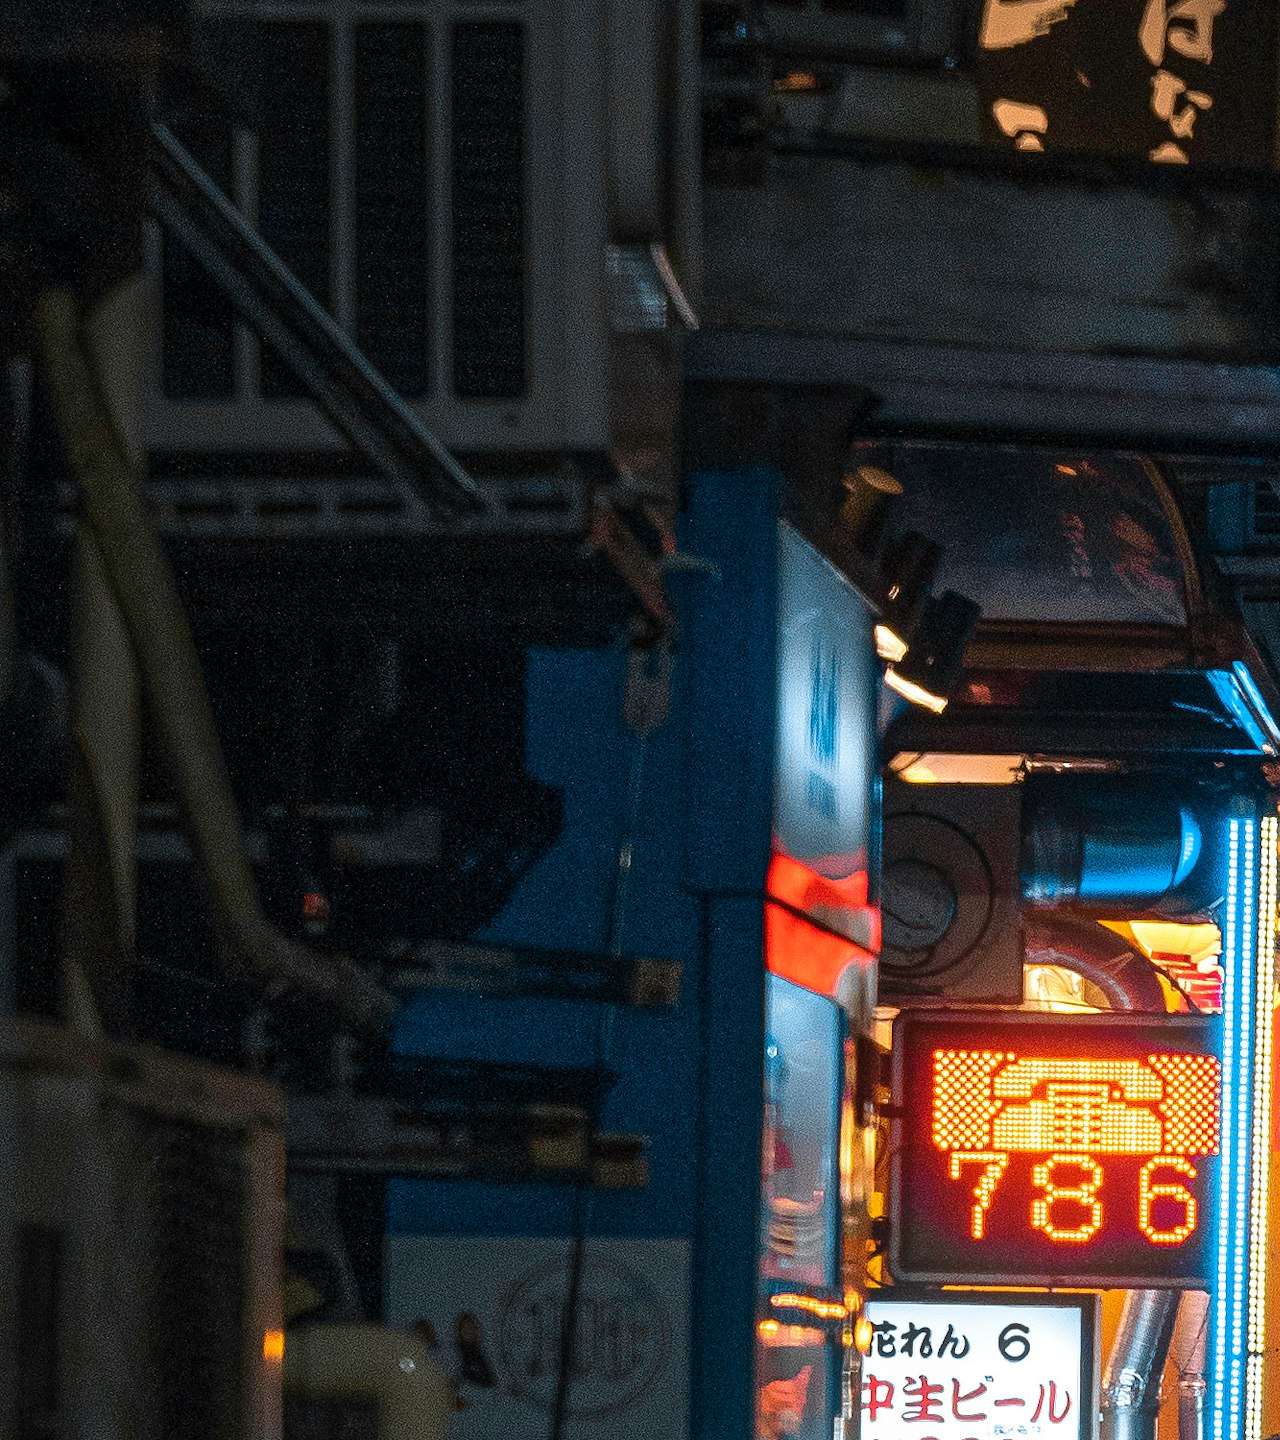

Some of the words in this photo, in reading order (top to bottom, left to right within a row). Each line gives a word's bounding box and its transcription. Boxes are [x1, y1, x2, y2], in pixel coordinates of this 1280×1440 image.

[868, 1321, 970, 1359] 花れん
[998, 1322, 1031, 1362] 6
[862, 1374, 1072, 1424] 中生ビール
